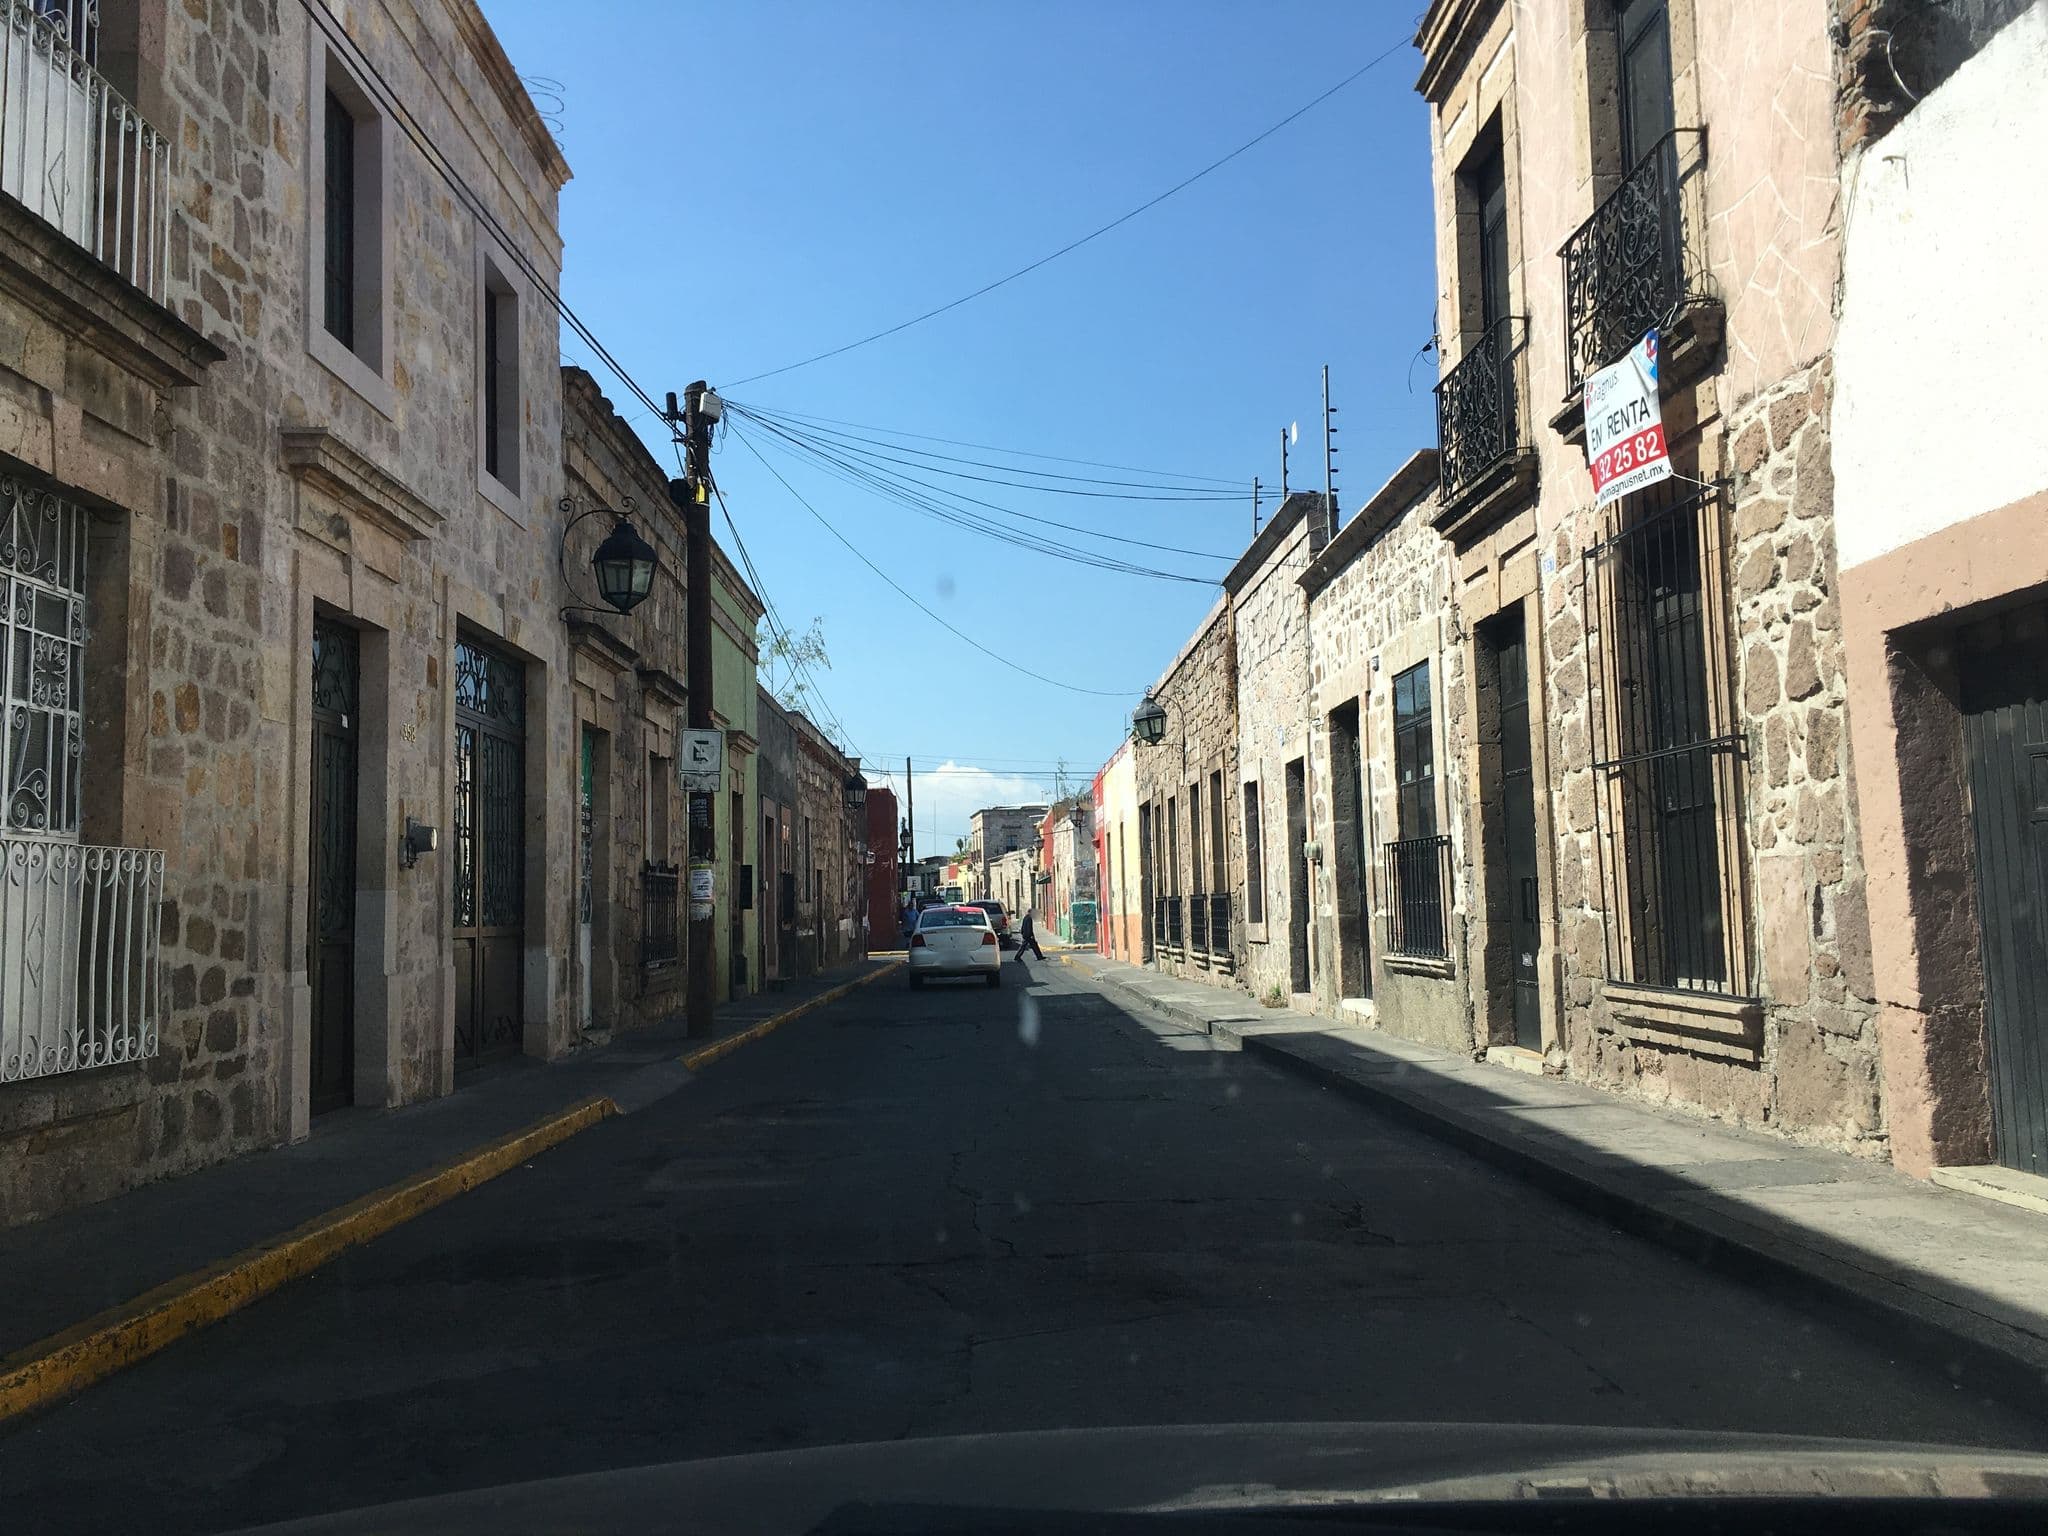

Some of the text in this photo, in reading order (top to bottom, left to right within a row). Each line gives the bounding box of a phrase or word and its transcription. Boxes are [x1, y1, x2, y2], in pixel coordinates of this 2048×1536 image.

[1591, 424, 1603, 452] EN
[1607, 396, 1651, 440] RENTA
[1614, 443, 1633, 473] 25
[1635, 431, 1662, 462] 82
